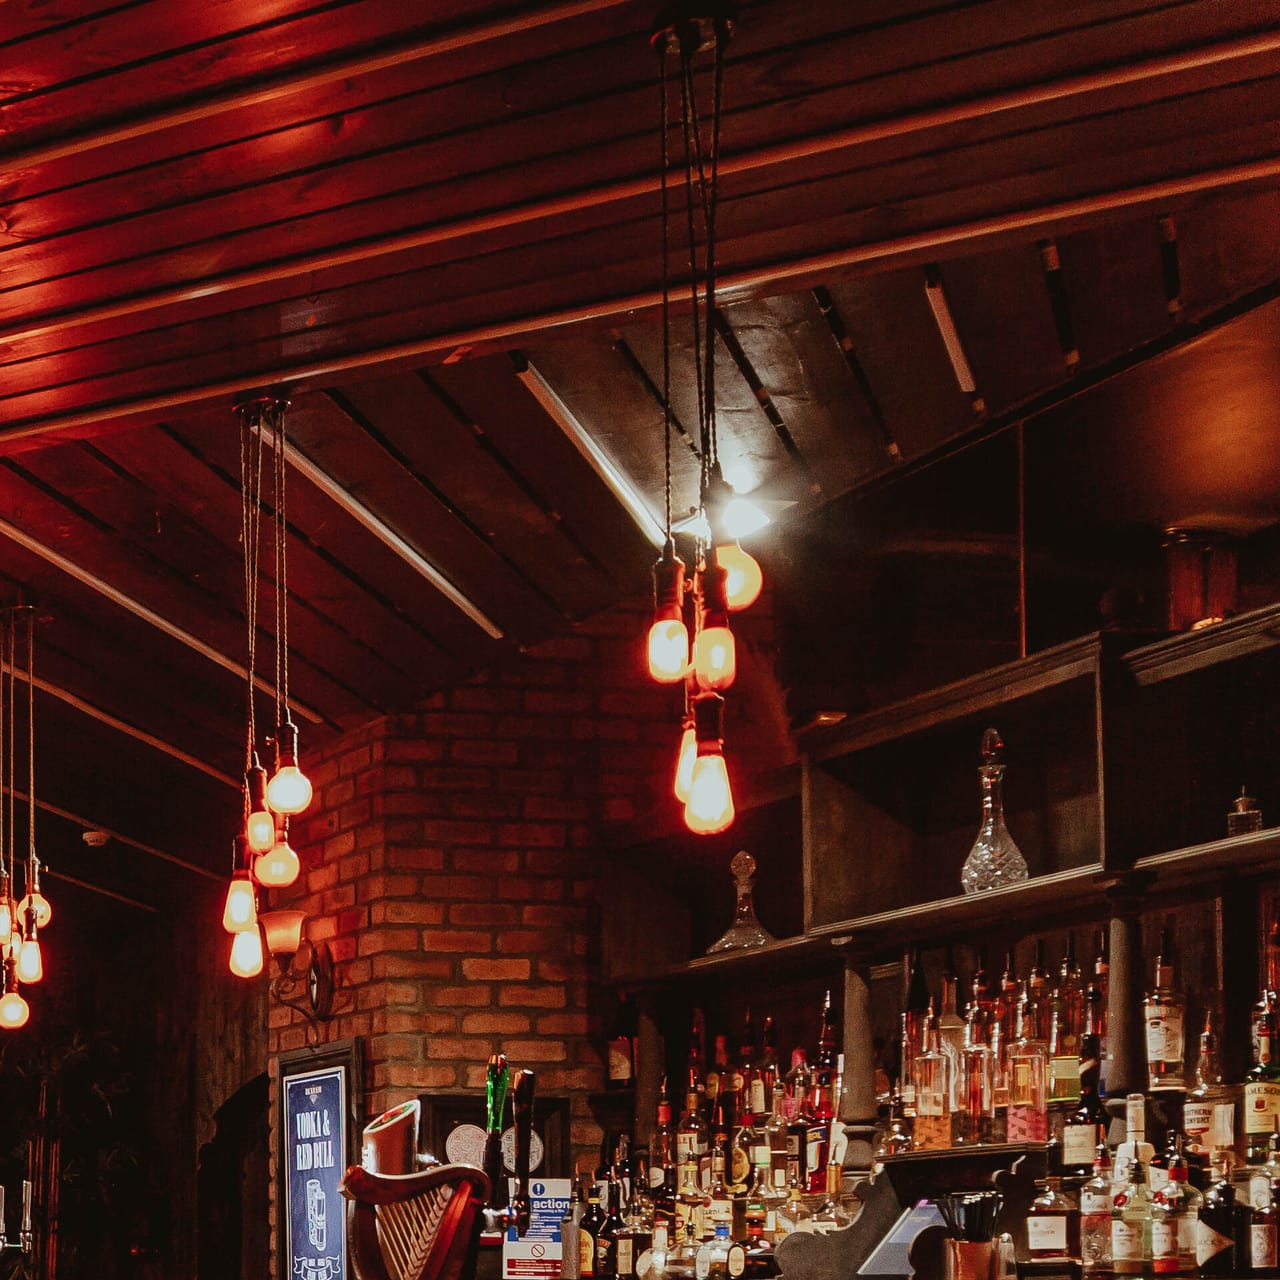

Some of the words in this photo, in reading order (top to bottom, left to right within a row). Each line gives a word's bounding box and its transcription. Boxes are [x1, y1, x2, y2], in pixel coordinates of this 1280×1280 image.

[296, 1110, 322, 1139] VODKA
[323, 1108, 331, 1137] &
[296, 1143, 313, 1171] RED
[313, 1140, 335, 1169] BULL
[533, 1198, 570, 1209] action
